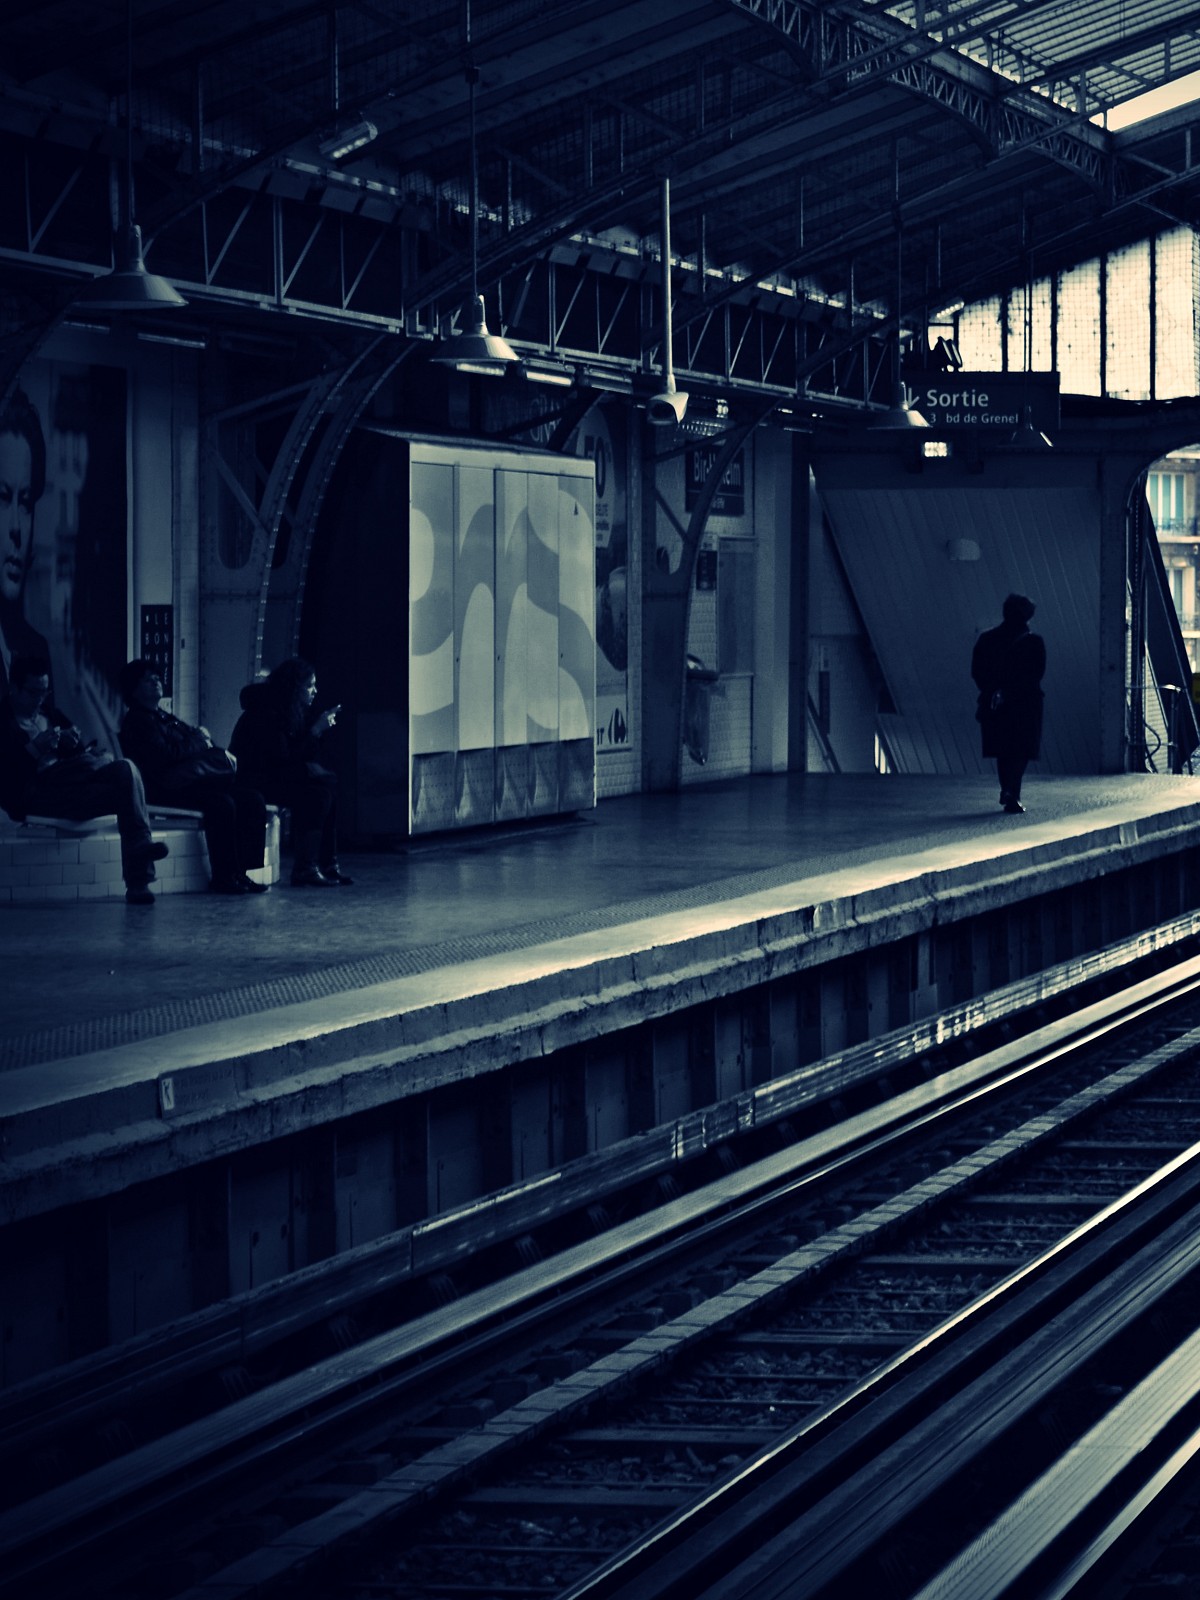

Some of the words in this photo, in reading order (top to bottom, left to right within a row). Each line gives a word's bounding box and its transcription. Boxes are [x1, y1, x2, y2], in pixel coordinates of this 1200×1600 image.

[926, 388, 989, 407] Sortie
[946, 413, 960, 424] bd
[963, 413, 977, 424] de
[981, 413, 1019, 424] Grenel
